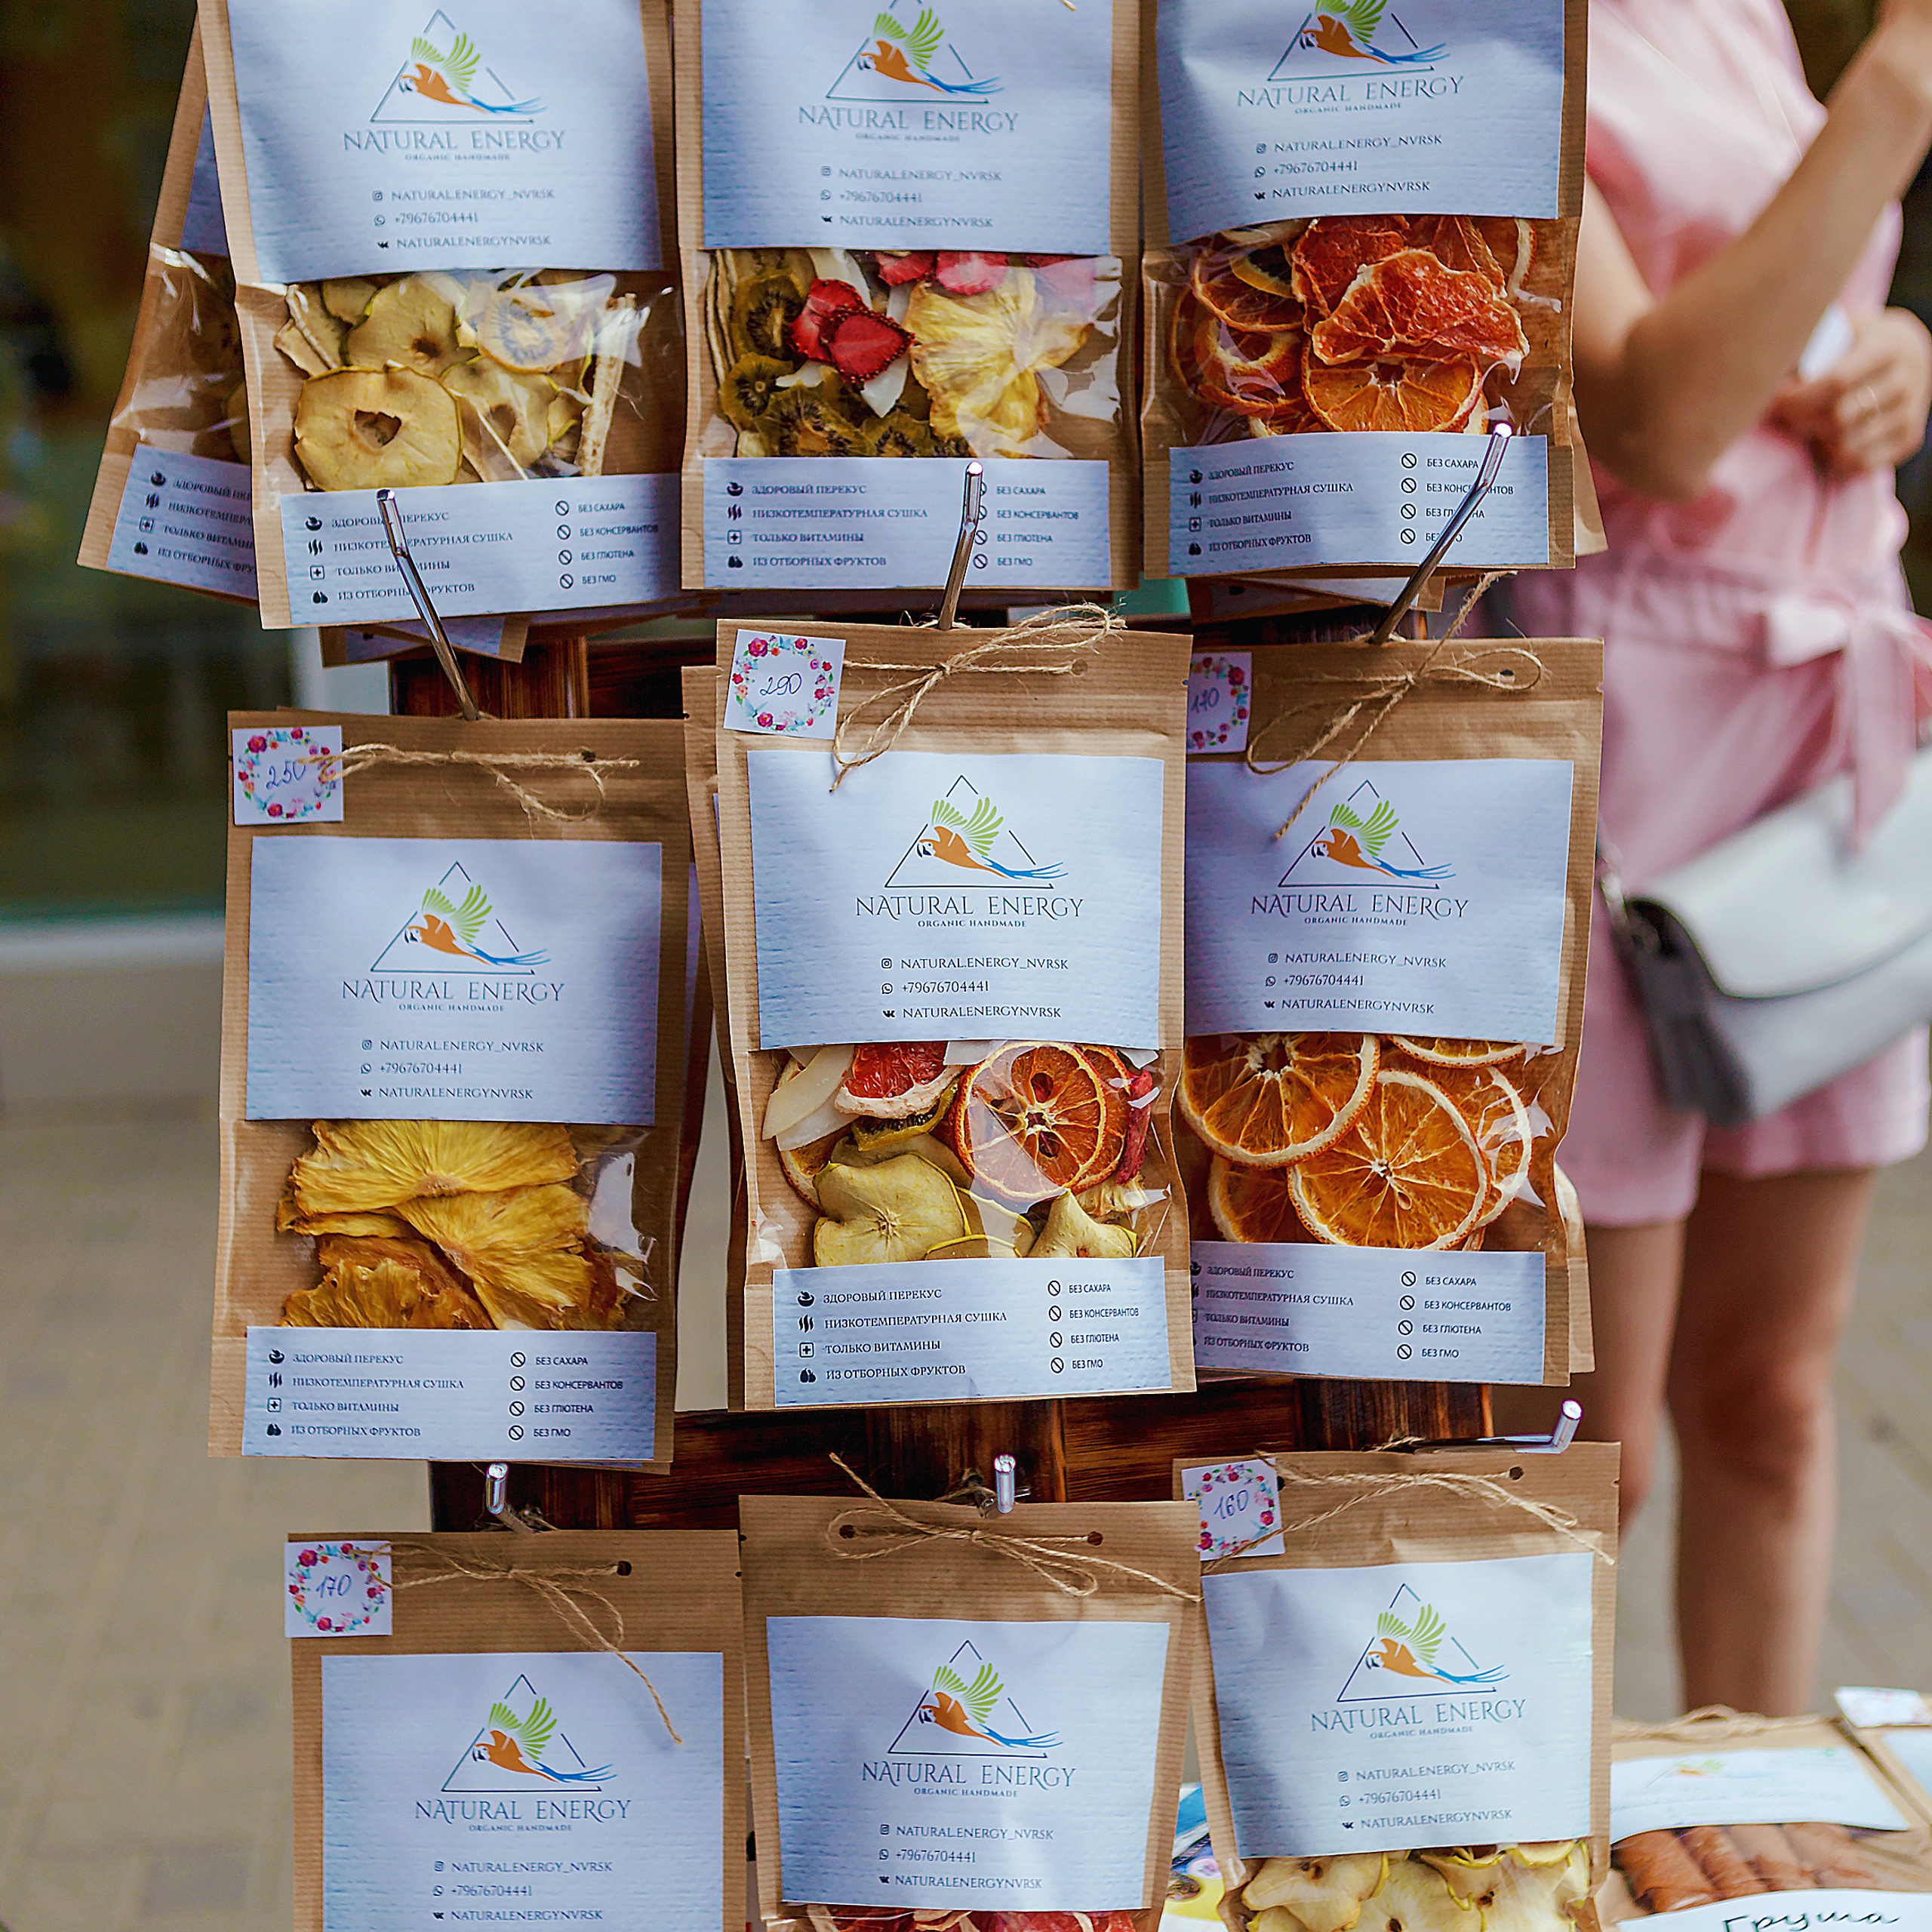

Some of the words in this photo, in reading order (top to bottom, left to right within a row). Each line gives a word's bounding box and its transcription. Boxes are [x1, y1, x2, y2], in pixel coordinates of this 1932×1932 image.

[1238, 84, 1350, 109] NATURAL
[1366, 75, 1464, 100] ENERGY
[1346, 103, 1401, 111] HANDMADE
[798, 105, 909, 131] NATURAL
[924, 110, 1019, 134] ENERGY
[343, 130, 457, 154] NATURAL
[471, 130, 565, 153] ENERGY
[1275, 160, 1358, 174] +79676704441
[1272, 181, 1430, 198] NATURALENERGYNVRSK
[840, 190, 922, 203] +79676704441
[395, 212, 478, 224] +79676704441
[840, 215, 994, 227] NATURALENERGYNVRSK
[396, 235, 551, 248] NATURALENERGYNVRSK
[1254, 462, 1294, 475] ПЕРЕКУС
[1427, 459, 1442, 467] БЕЗ
[1444, 459, 1478, 468] САХАРА
[752, 485, 814, 494] ЗДОРОВЫЙ
[817, 485, 866, 494] ПЕРЕКУС
[997, 486, 1011, 494] БЕЗ
[1312, 483, 1353, 494] СУШКА
[1426, 484, 1442, 492] БЕЗ
[578, 504, 592, 512] БЕЗ
[594, 503, 625, 512] САХАРА
[753, 509, 884, 518] НИЗКОТЕМПЕРАТУРНАЯ
[888, 509, 928, 518] СУШКА
[1426, 509, 1441, 517] БЕЗ
[1014, 511, 1078, 519] КОНСЕРВАНТОВ
[1209, 517, 1241, 528] ТОЛЬКО
[1243, 511, 1291, 525] ВИТАМИНЫ
[164, 525, 204, 540] ТОЛЬКО
[580, 528, 594, 537] БЕЗ
[595, 525, 658, 535] КОНСЕРВАНТОВ
[472, 533, 513, 543] СУШКА
[800, 534, 864, 542] ВИТАМИНЫ
[1014, 534, 1053, 543] ГЛЮТЕНА
[1223, 538, 1268, 550] ОТБОРНЫХ
[1269, 534, 1312, 545] ФРУКТОВ
[597, 550, 634, 559] ГЛЮТЕНА
[753, 558, 767, 566] ИЗ
[770, 557, 832, 566] ОТБОРНЫХ
[833, 557, 887, 566] ФРУКТОВ
[998, 558, 1012, 566] БЕЗ
[337, 566, 382, 576] ТОЛЬКО
[583, 576, 596, 584] БЕЗ
[338, 592, 353, 601] ИЗ
[760, 673, 801, 696] 290
[266, 759, 306, 789] 250
[856, 894, 974, 920] NATURAL
[989, 896, 1084, 920] ENERGY
[1251, 894, 1358, 918] NATURAL
[1372, 894, 1469, 920] ENERGY
[918, 919, 965, 928] ORGANIC
[970, 919, 1026, 928] HANDMADE
[1305, 916, 1348, 924] ORGANIC
[1352, 917, 1407, 926] HANDMADE
[901, 957, 1069, 970] NATURAL.ENERGY_NVRSK
[1285, 953, 1447, 968] NATURAL.ENERGY_NVRSK
[901, 980, 989, 993] +79676704441
[1284, 975, 1364, 986] +79676704441
[342, 979, 454, 1003] NATURAL
[469, 982, 565, 1005] ENERGY
[903, 1006, 1061, 1018] NATURALENERGYNVRSK
[1281, 998, 1434, 1014] NATURALENERGYNVRSK
[380, 1040, 544, 1053] NATURAL.ENERGY_NVRSK
[380, 1063, 463, 1075] +79676704441
[379, 1088, 534, 1099] NATURALENERGYNVRSK
[1254, 1269, 1294, 1278] ПЕРЕКУС
[1443, 1277, 1477, 1285] САХАРА
[1069, 1284, 1082, 1293] БЕЗ
[1084, 1284, 1111, 1292] САХАРА
[823, 1291, 886, 1304] ЗДОРОВЫЙ
[889, 1289, 942, 1300] ПЕРЕКУС
[1207, 1290, 1309, 1303] НИЗКОТЕМПЕРАТУРНАЯ
[1313, 1296, 1353, 1306] СУШКА
[1441, 1301, 1511, 1311] КОНСЕРВАНТОВ
[1069, 1310, 1083, 1318] БЕЗ
[1084, 1308, 1139, 1318] КОНСЕРВАНТОВ
[825, 1315, 961, 1328] НИЗКОТЕМПЕРАТУРНАЯ
[964, 1312, 1007, 1322] СУШКА
[1206, 1313, 1238, 1323] ТОЛЬКО
[1240, 1315, 1289, 1326] ВИТАМИНЫ
[1423, 1324, 1438, 1333] БЕЗ
[1440, 1325, 1481, 1334] ГЛЮТЕНА
[1071, 1335, 1084, 1343] БЕЗ
[1086, 1334, 1119, 1343] ГЛЮТЕНА
[1204, 1337, 1215, 1345] ИЗ
[1217, 1338, 1263, 1349] ОТБОРНЫХ
[1265, 1342, 1309, 1352] ФРУКТОВ
[825, 1343, 871, 1354] ТОЛЬКО
[874, 1340, 940, 1352] ВИТАМИНЫ
[293, 1353, 352, 1364] ЗДОРОВЫЙ
[355, 1355, 404, 1364] ПЕРЕКУС
[1422, 1349, 1437, 1357] БЕЗ
[1439, 1349, 1460, 1358] ГМО
[1072, 1360, 1085, 1368] БЕЗ
[1088, 1359, 1103, 1367] ГМО
[826, 1371, 841, 1380] ИЗ
[844, 1367, 907, 1379] ОТБОРНЫХ
[910, 1364, 966, 1377] ФРУКТОВ
[293, 1378, 420, 1389] НИЗКОТЕМПЕРАТУРНАЯ
[423, 1380, 464, 1389] СУШКА
[552, 1381, 623, 1389] КОНСЕРВАНТОВ
[292, 1402, 334, 1411] ТОЛЬКО
[337, 1402, 398, 1412] ВИТАМИНЫ
[308, 1426, 367, 1435] ОТБОРНЫХ
[370, 1428, 421, 1437] ФРУКТОВ
[1214, 1490, 1248, 1519] 160
[315, 1574, 352, 1598] 170
[1311, 1706, 1423, 1734] NATURAL
[1436, 1699, 1526, 1723] ENERGY
[1370, 1730, 1416, 1739] ORGANIC
[1419, 1726, 1472, 1735] HANDMADE
[862, 1761, 967, 1786] NATURAL
[982, 1764, 1077, 1791] ENERGY
[914, 1787, 958, 1796] ORGANIC
[1359, 1789, 1441, 1804] +79676704441
[415, 1799, 521, 1824] NATURAL
[537, 1799, 632, 1823] ENERGY
[1361, 1810, 1512, 1829] NATURALENERGYNVRSK
[896, 1850, 976, 1863] +79676704441
[895, 1875, 1042, 1888] NATURALENERGYNVRSK
[451, 1911, 603, 1920] NATURALENERGYNVRSK
[1723, 1911, 1900, 1932] Груша
